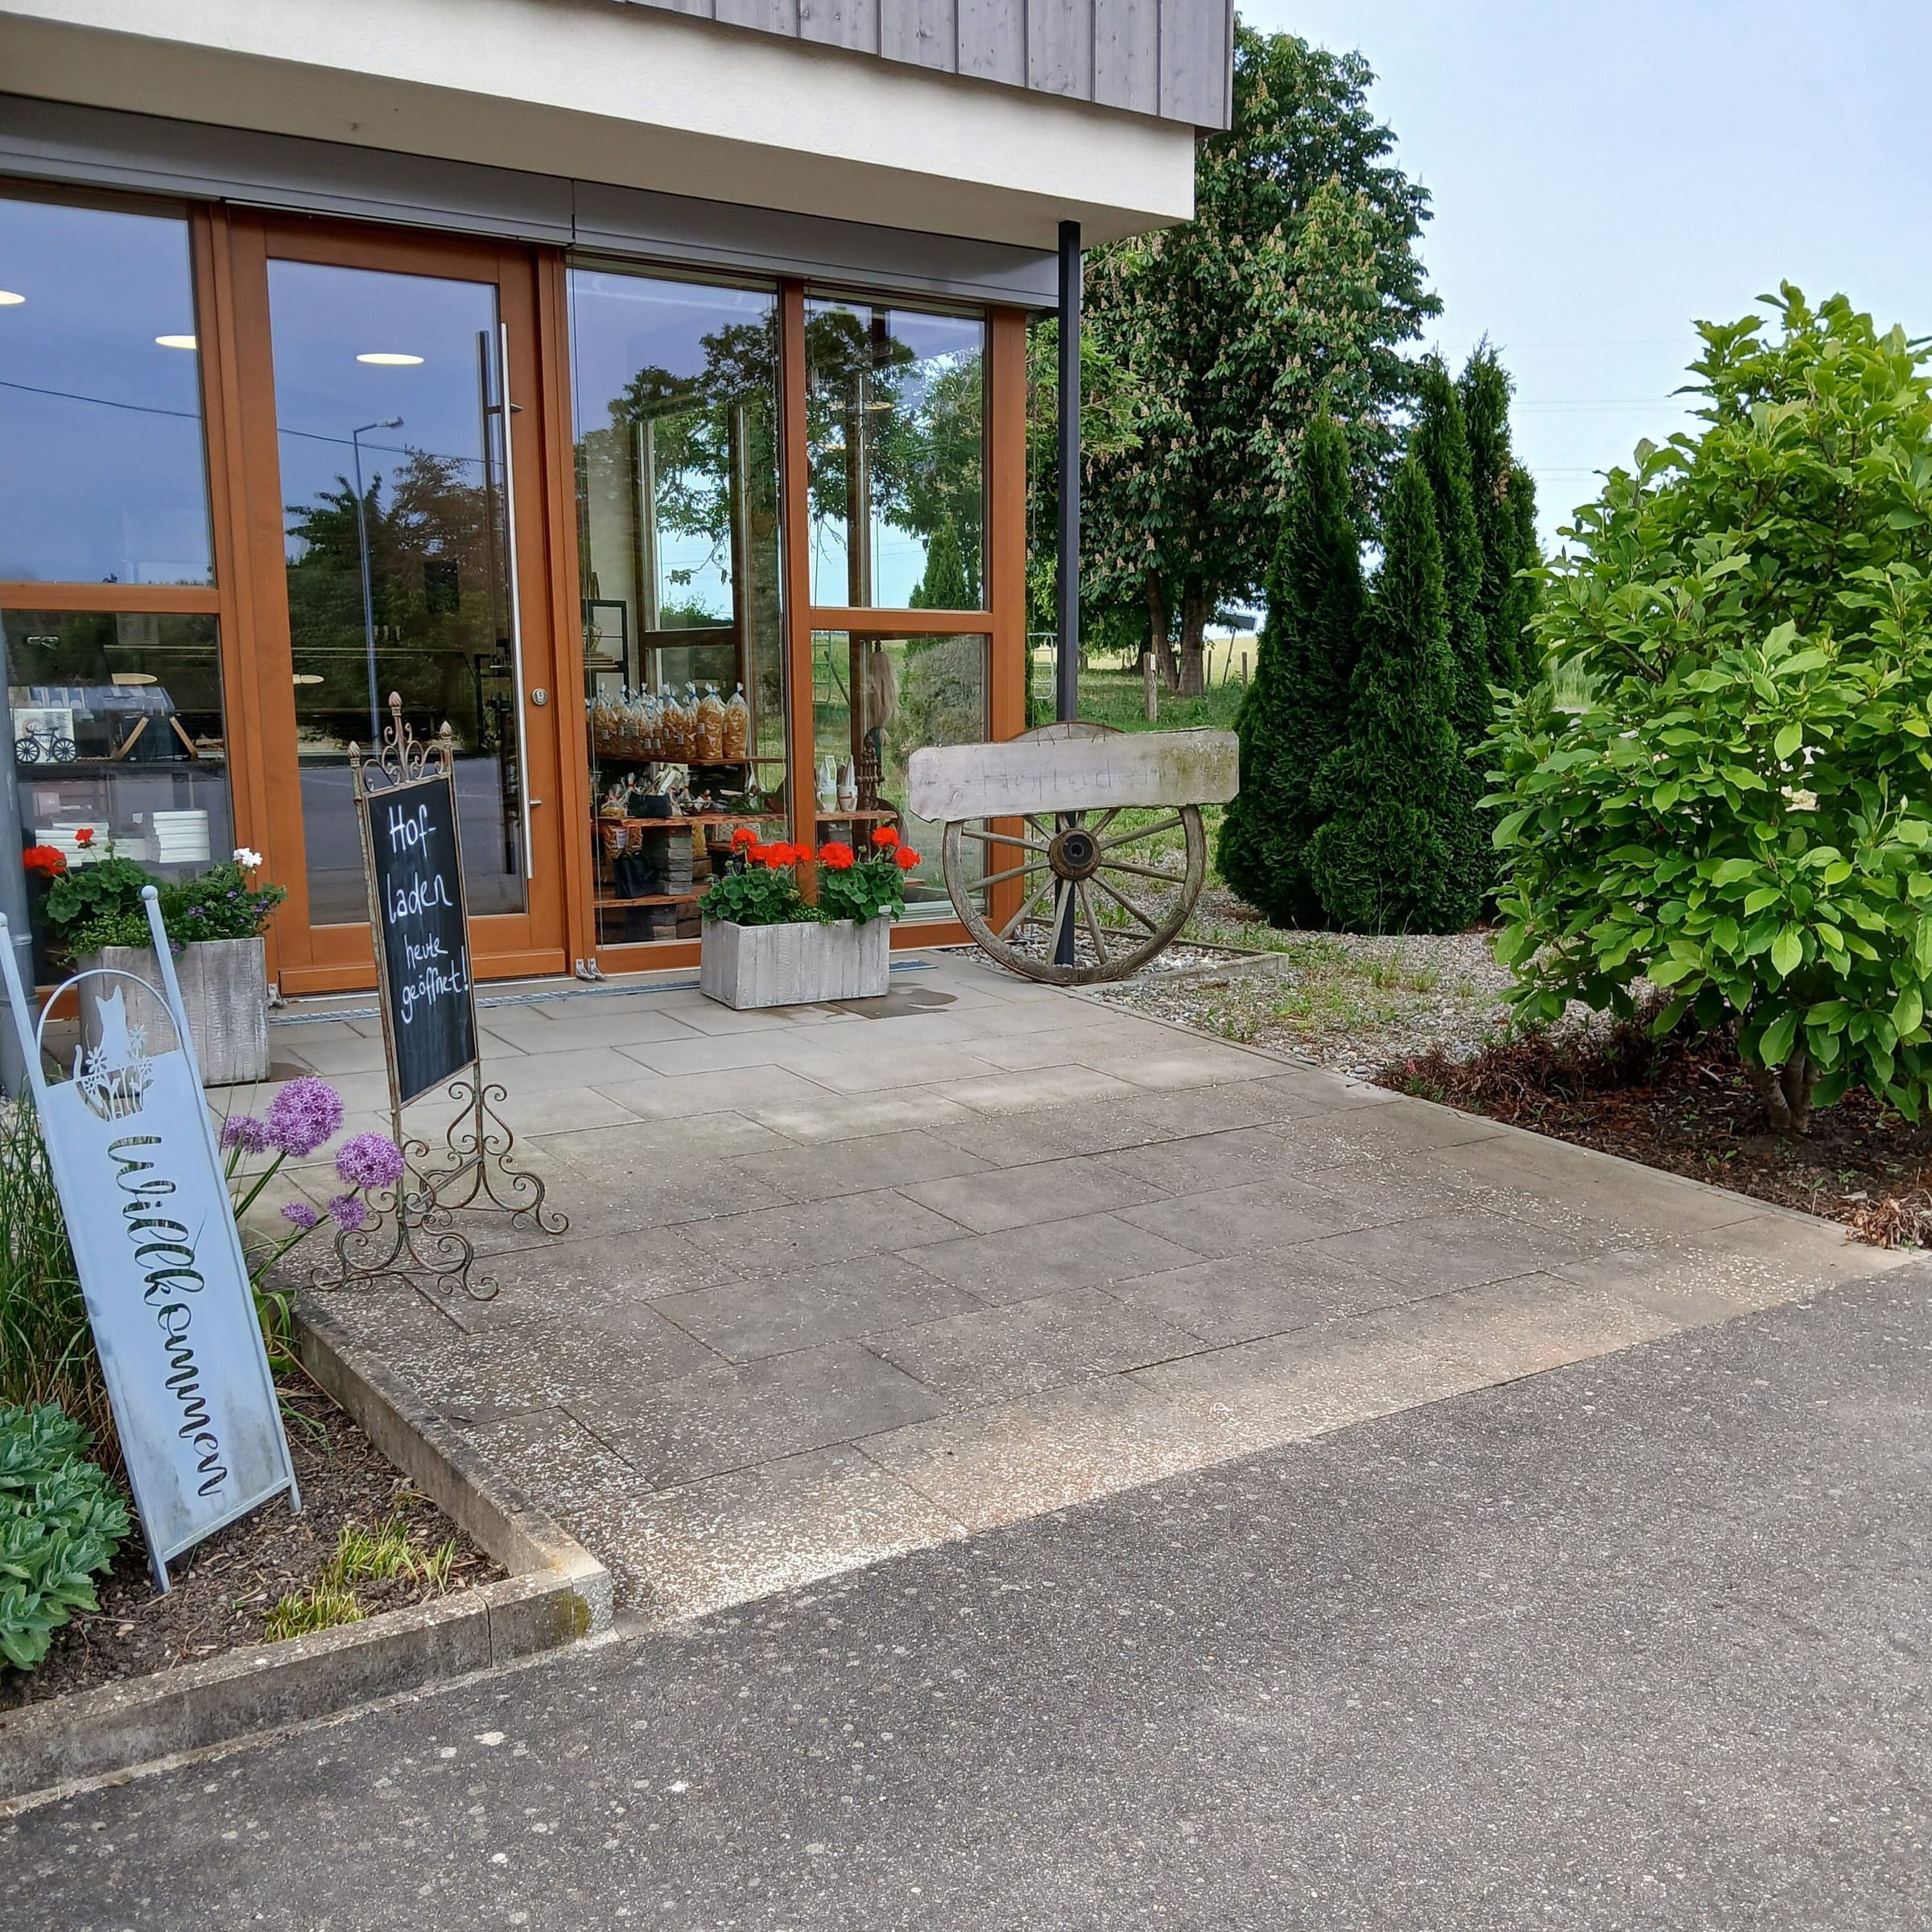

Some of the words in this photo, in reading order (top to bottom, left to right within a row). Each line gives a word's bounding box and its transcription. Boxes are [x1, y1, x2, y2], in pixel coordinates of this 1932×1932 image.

[389, 803, 438, 858] Hof-
[386, 872, 453, 925] laden
[403, 932, 448, 970] heute
[400, 945, 469, 1025] geöffnet!
[107, 1135, 229, 1497] Willkommen
